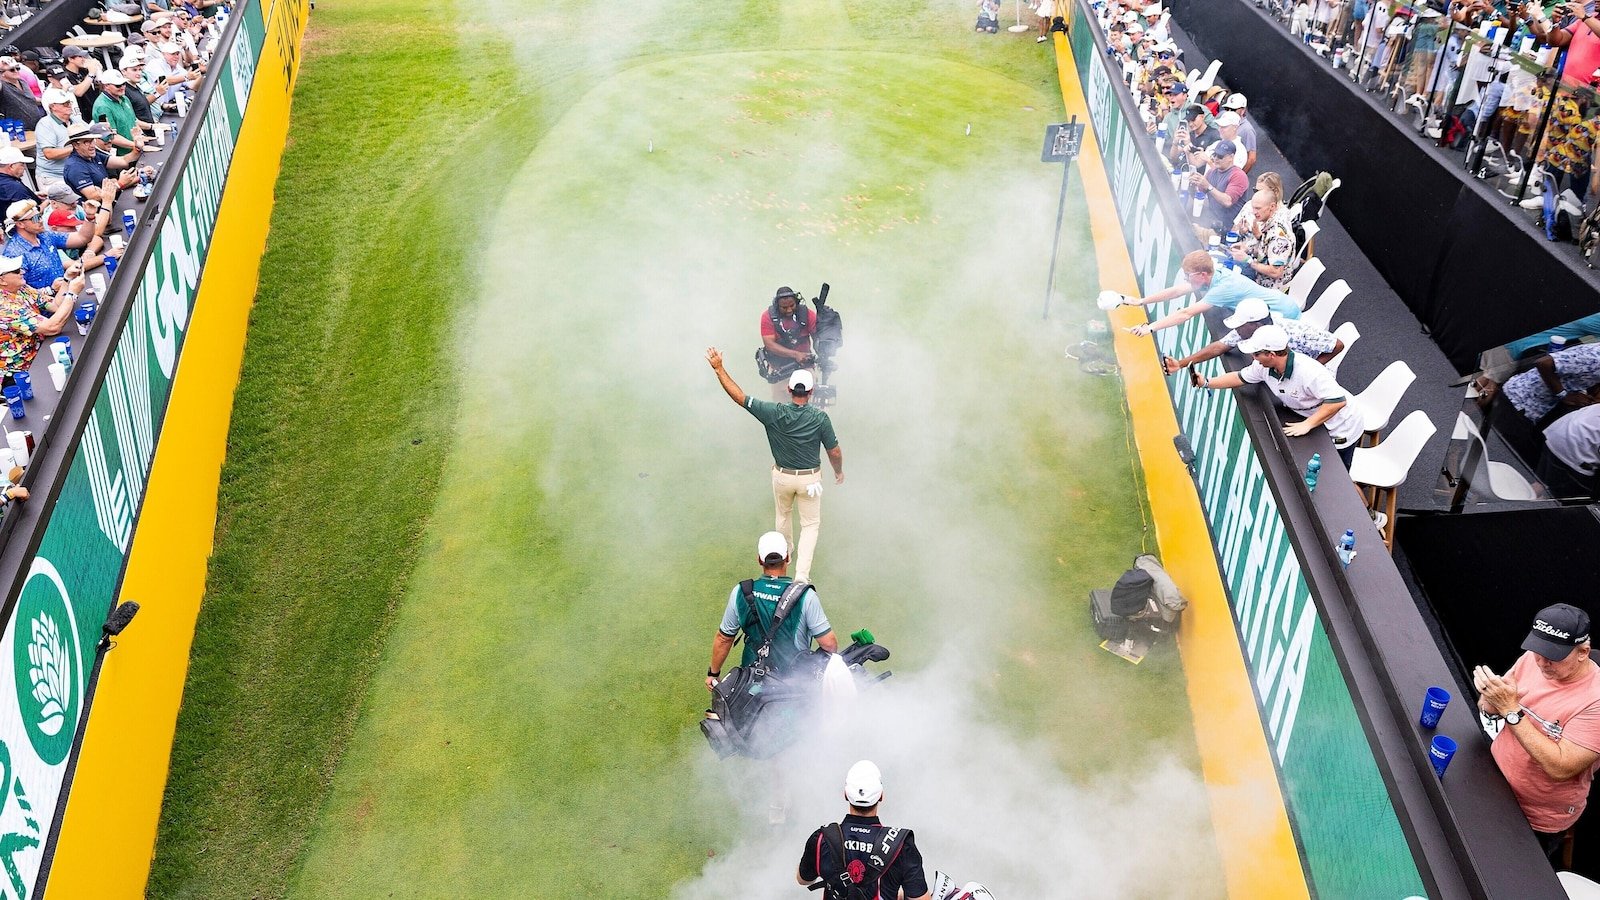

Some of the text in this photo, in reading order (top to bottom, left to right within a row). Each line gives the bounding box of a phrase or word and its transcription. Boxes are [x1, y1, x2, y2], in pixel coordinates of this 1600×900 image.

[81, 278, 154, 556] LIV
[144, 163, 201, 380] GOLF
[1113, 108, 1144, 226] LIV
[1208, 428, 1318, 768] AFRICA
[752, 590, 781, 602] HWAR
[1532, 619, 1571, 640] Titleist
